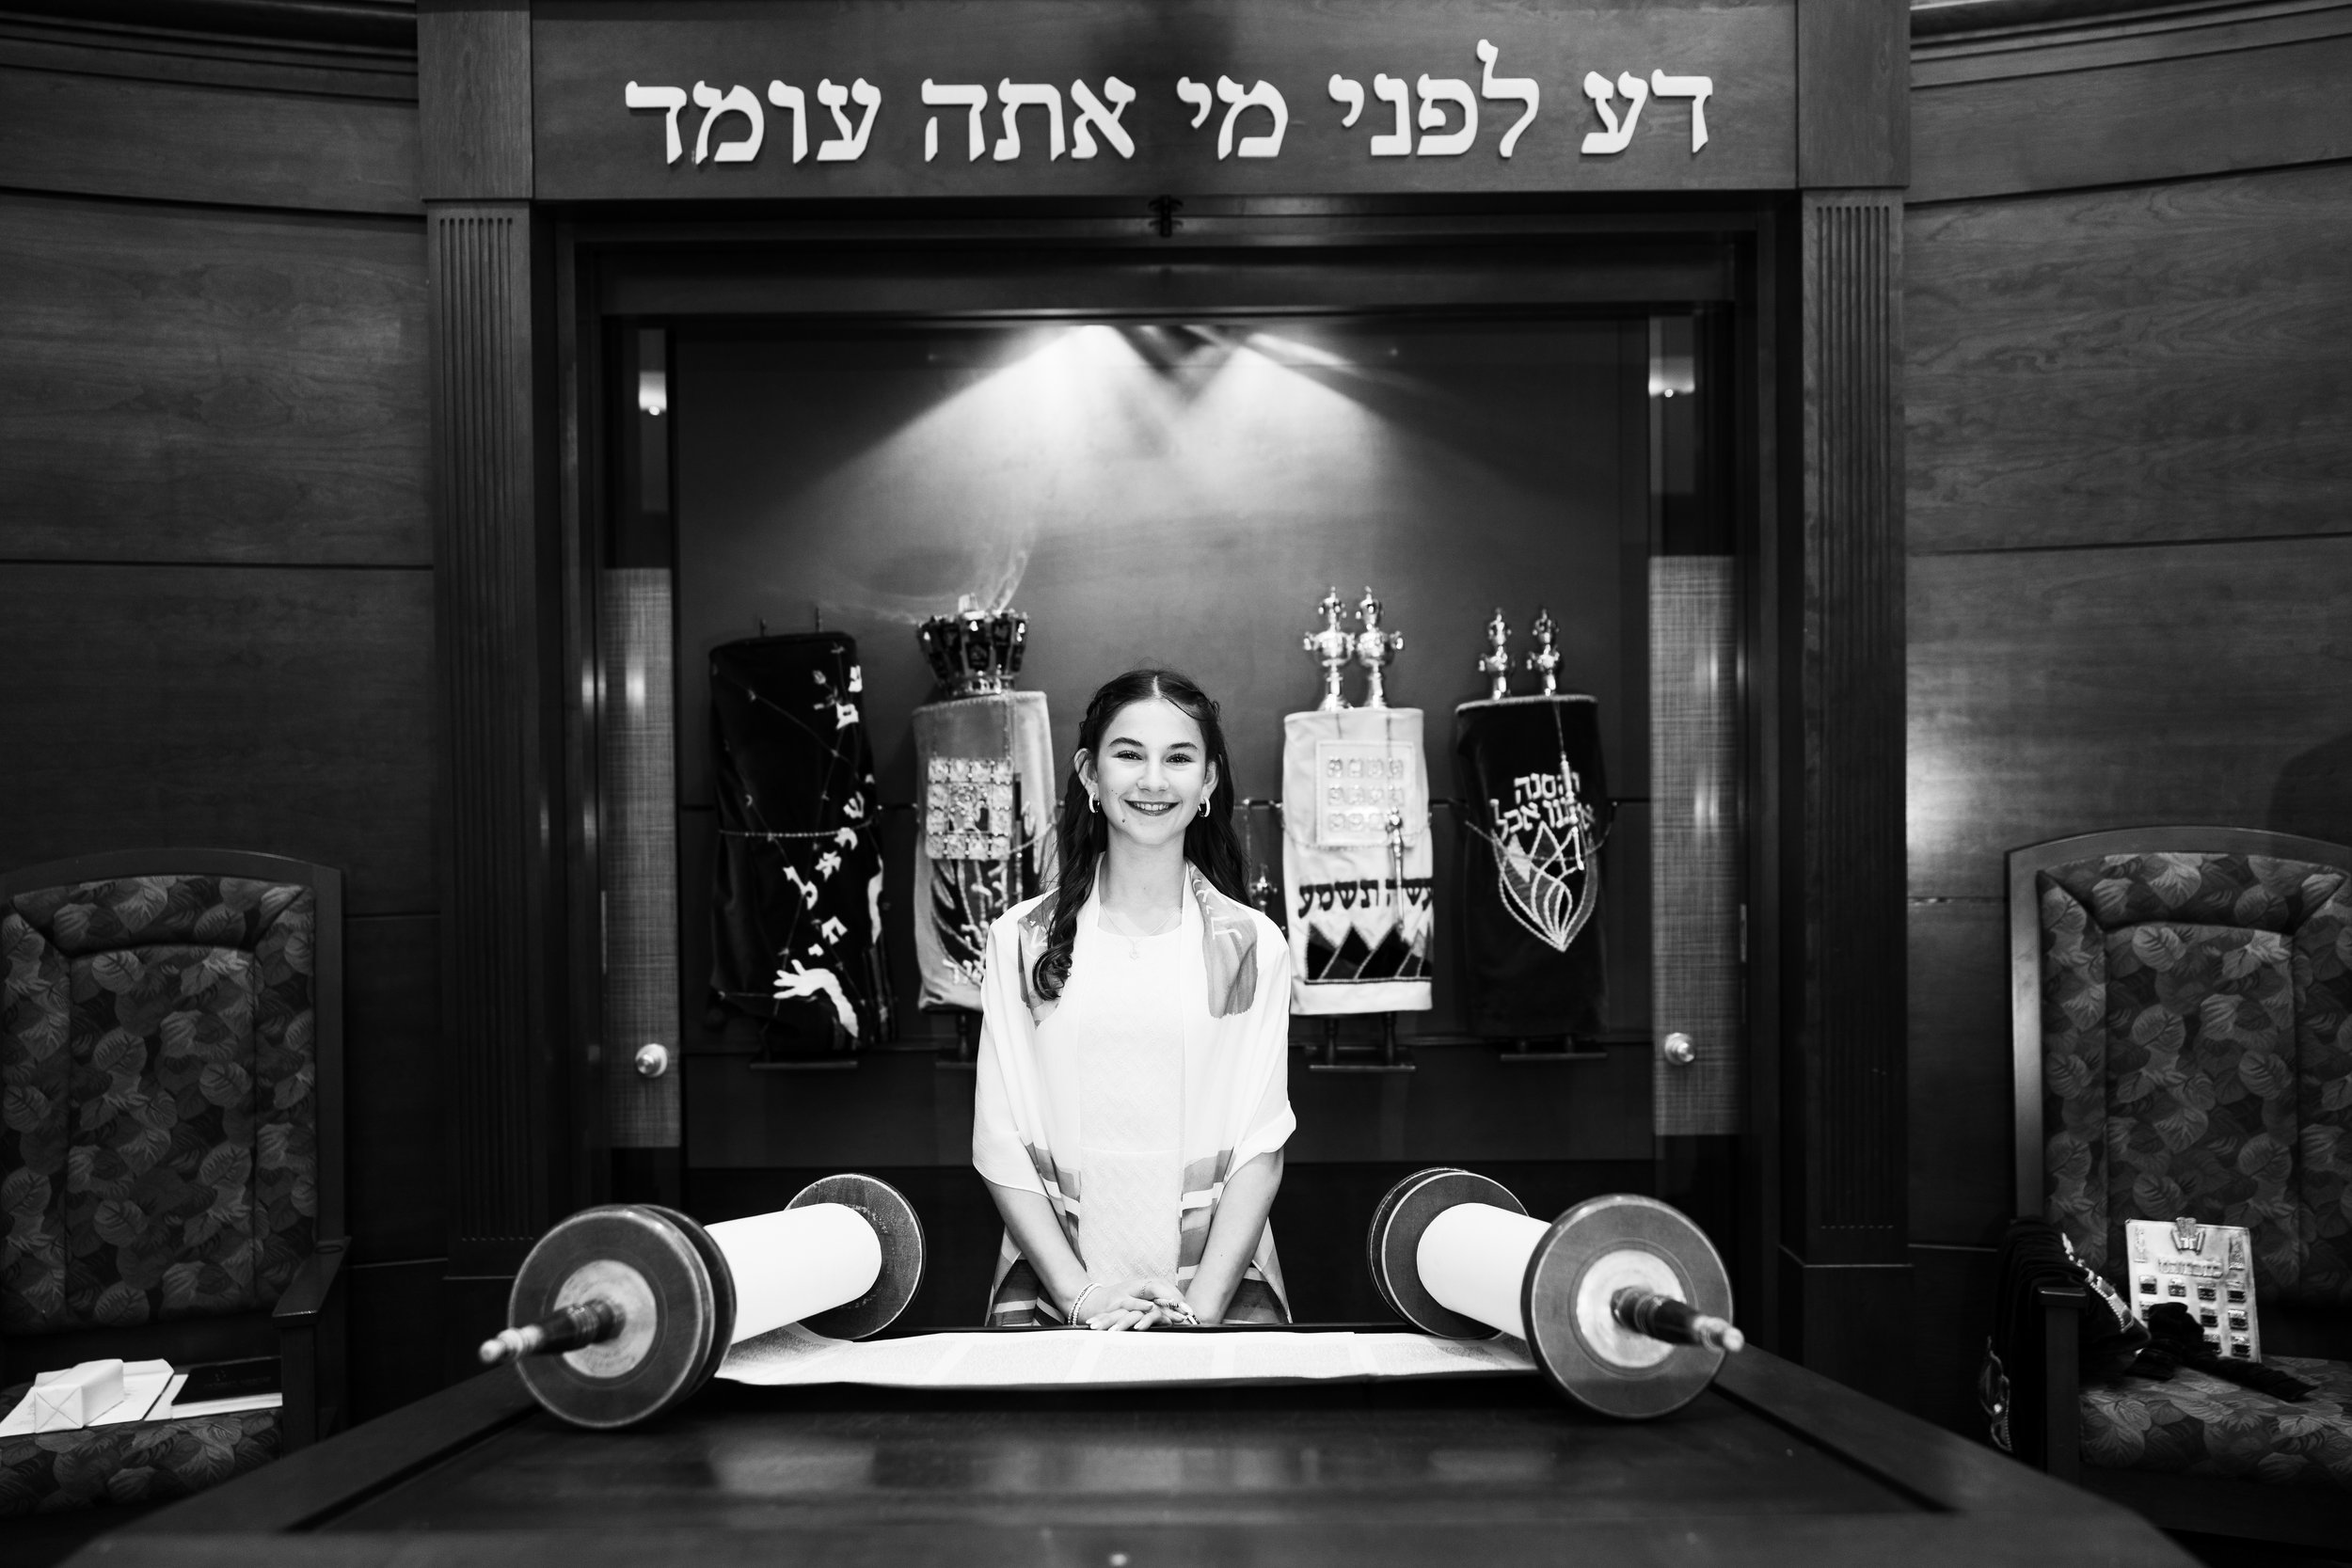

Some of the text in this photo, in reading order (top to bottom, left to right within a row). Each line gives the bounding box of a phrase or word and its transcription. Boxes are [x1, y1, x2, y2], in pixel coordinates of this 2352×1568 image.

[625, 39, 1713, 165] דע לפני מי אתה עומד
